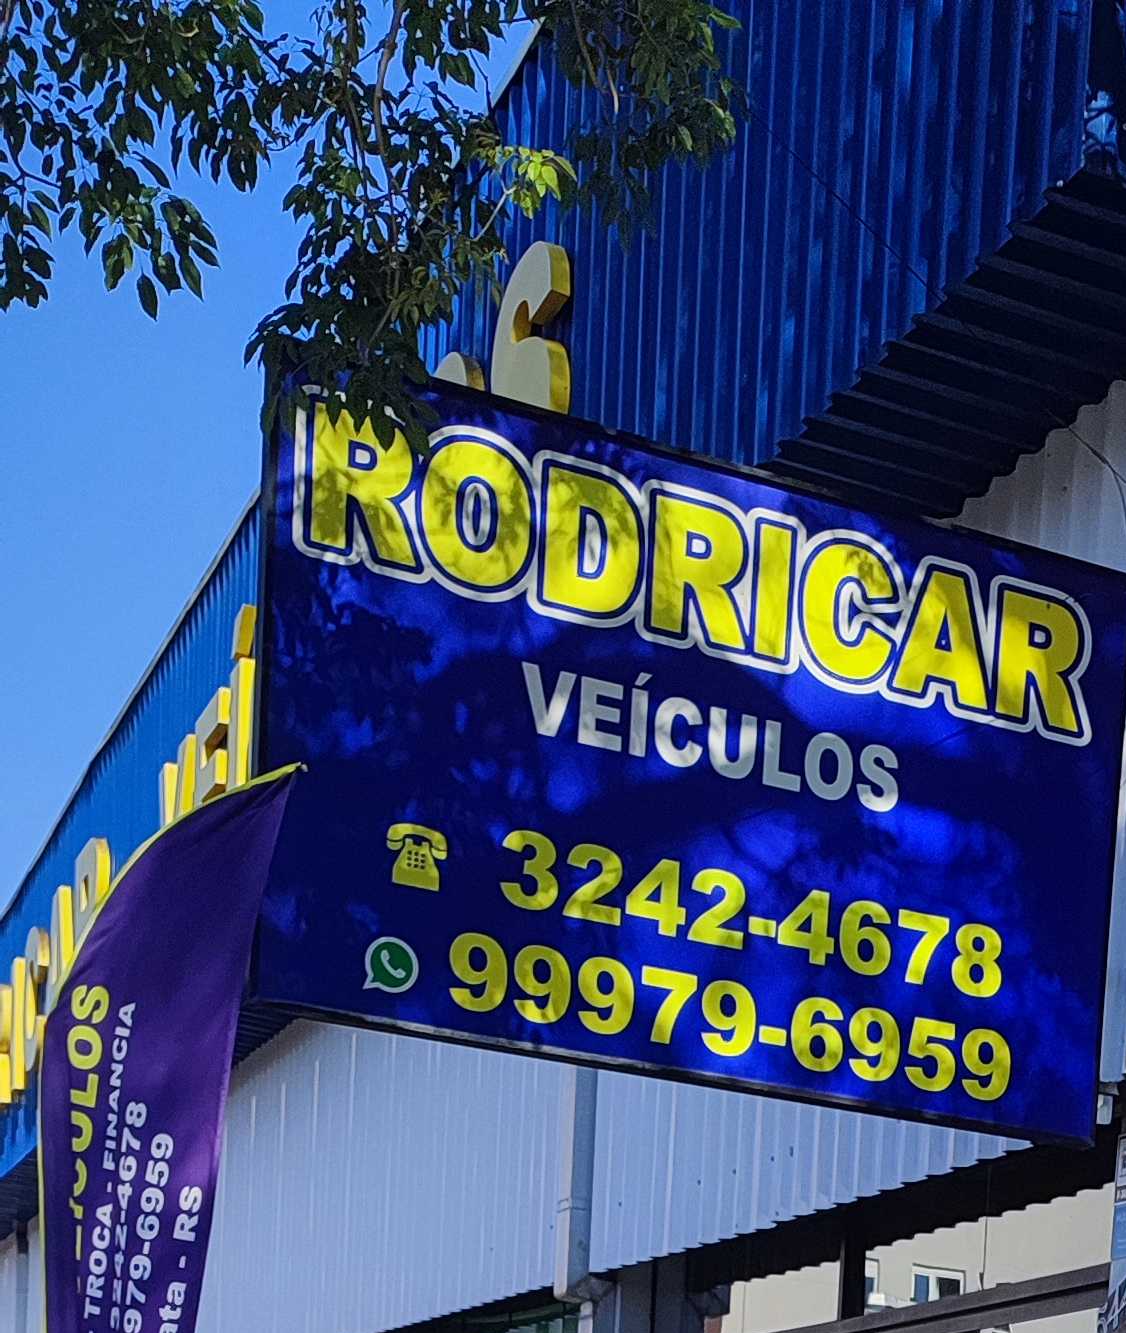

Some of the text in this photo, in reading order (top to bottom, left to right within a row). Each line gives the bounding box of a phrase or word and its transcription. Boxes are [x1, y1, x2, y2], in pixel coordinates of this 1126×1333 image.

[293, 384, 1092, 745] RODRICAR
[521, 659, 900, 812] VEÍCULOS
[499, 829, 1003, 998] 3242-4678
[448, 932, 1012, 1101] 99979-6959
[84, 1203, 114, 1319] TROCA
[102, 1002, 136, 1171] FINANCIA
[173, 1185, 202, 1242] RS
